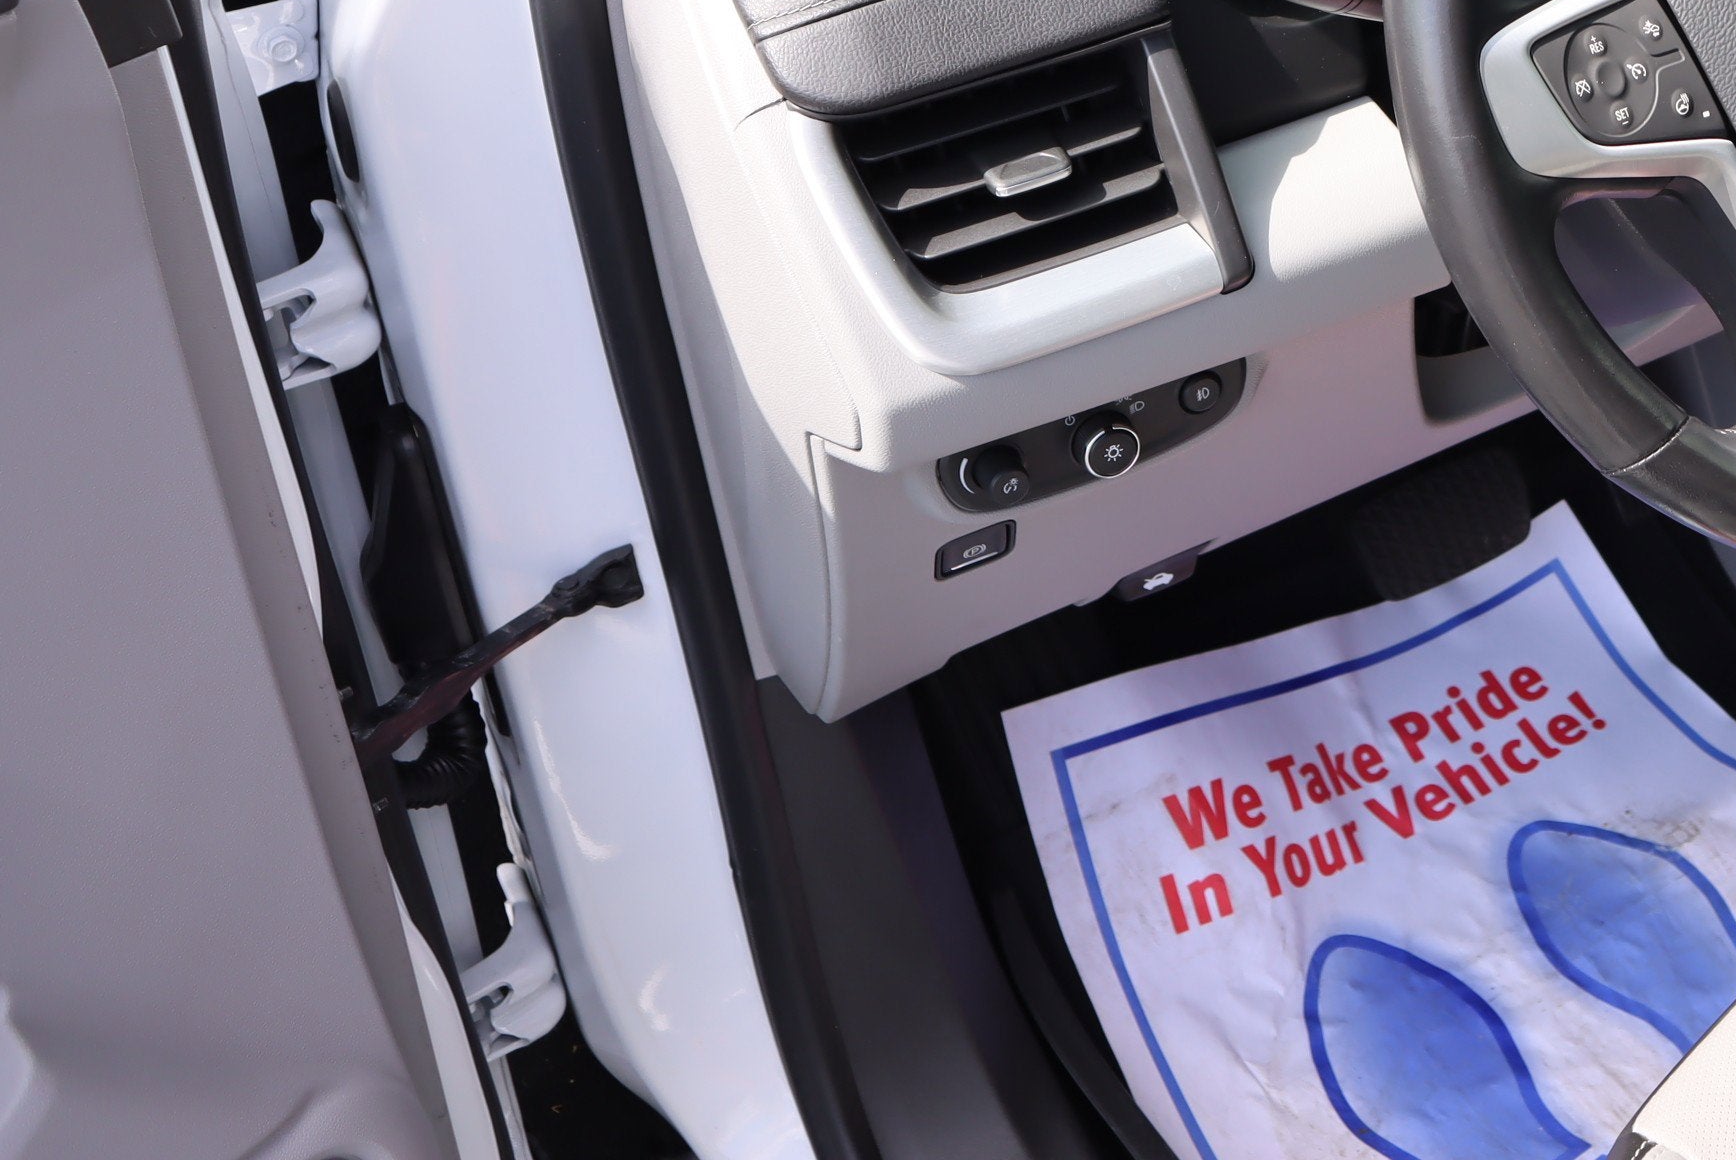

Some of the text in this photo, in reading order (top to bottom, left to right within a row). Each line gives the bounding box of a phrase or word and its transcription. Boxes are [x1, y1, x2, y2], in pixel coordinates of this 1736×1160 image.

[1589, 41, 1605, 54] RES
[1615, 107, 1629, 121] SET
[1162, 666, 1550, 851] We Take Pride
[1159, 690, 1606, 936] In Your Vehicle!
